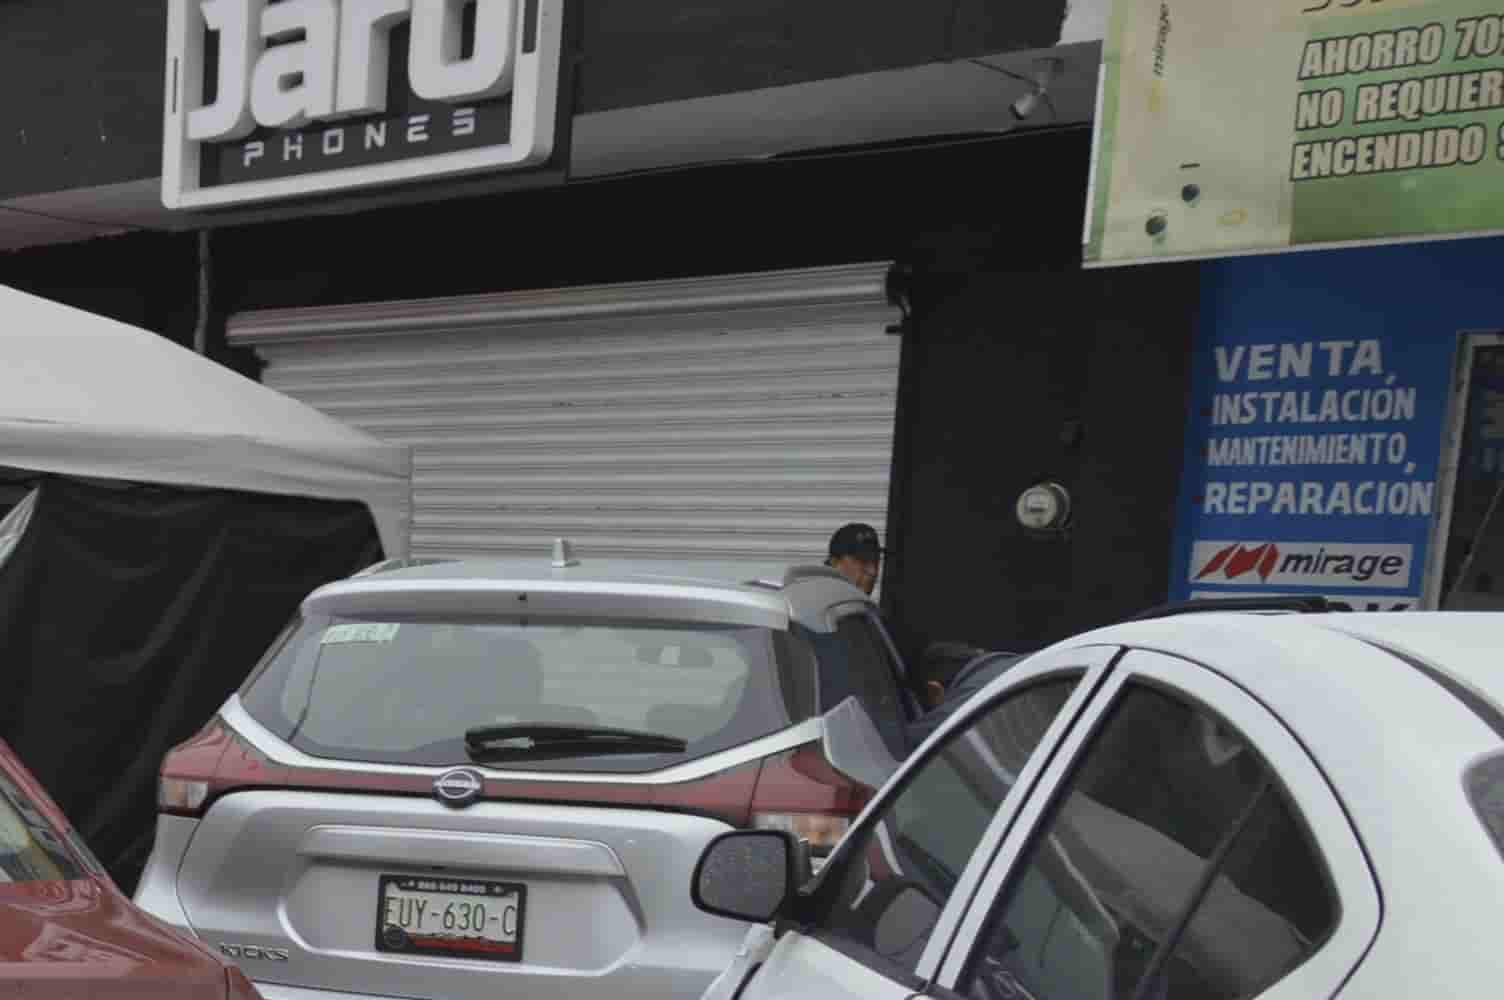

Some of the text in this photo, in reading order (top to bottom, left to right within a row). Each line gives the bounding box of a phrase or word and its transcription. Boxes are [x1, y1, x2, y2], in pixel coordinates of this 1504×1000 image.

[1298, 14, 1504, 80] AHORRO 70
[1294, 88, 1344, 131] NO
[243, 107, 476, 167] PHONES
[1290, 122, 1487, 182] ENCENDIDO
[1279, 548, 1404, 581] mirage
[384, 896, 516, 936] EUY-630-C
